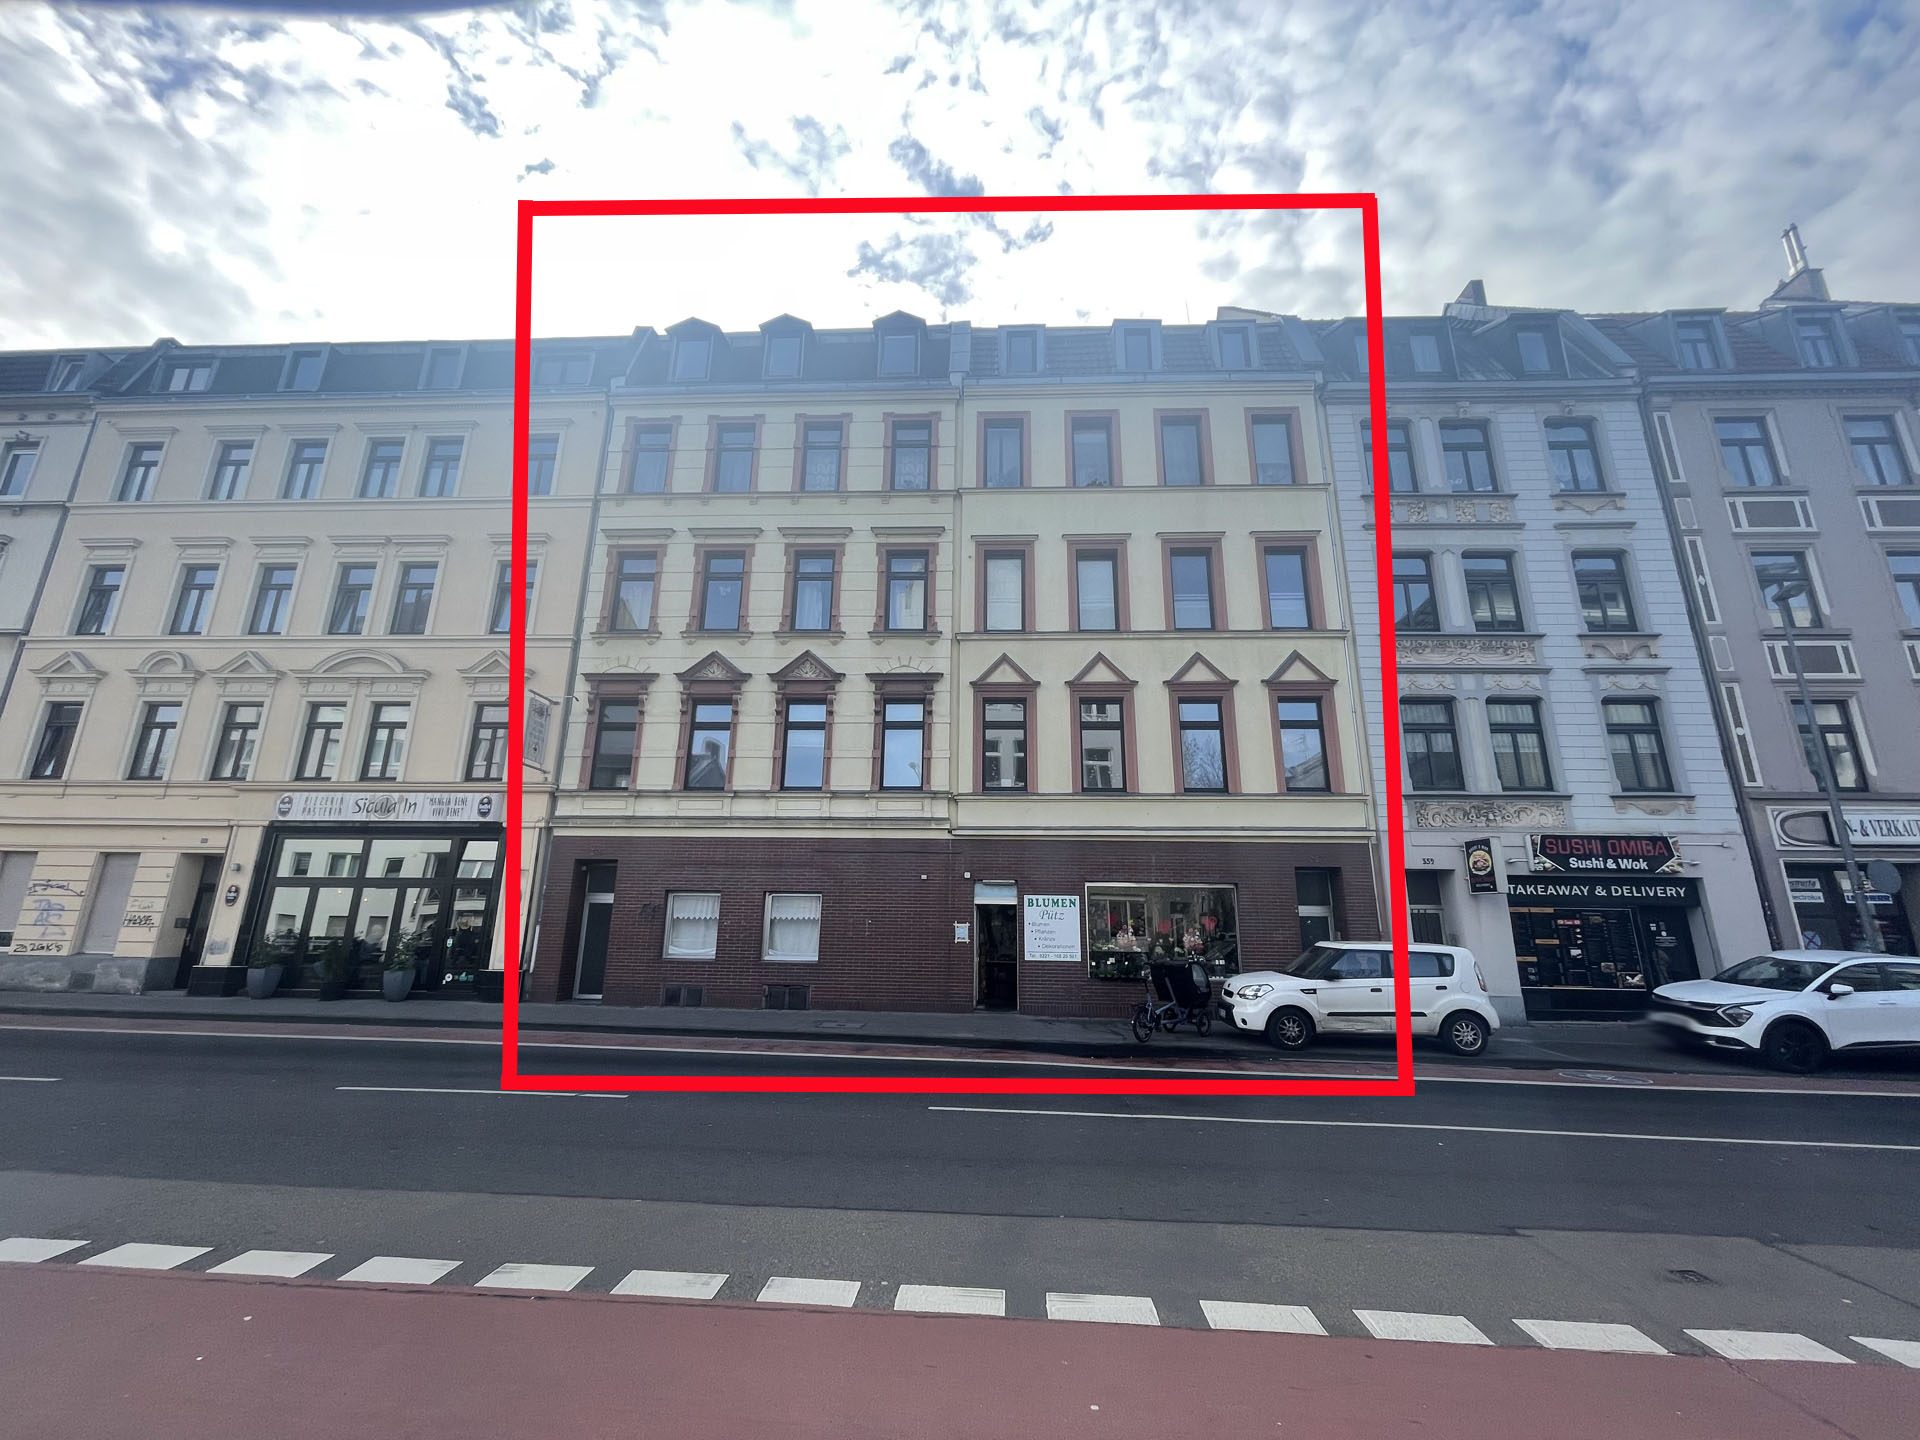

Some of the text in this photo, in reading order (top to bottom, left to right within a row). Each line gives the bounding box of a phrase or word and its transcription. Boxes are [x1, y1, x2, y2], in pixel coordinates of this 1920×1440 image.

[352, 797, 417, 814] Sicula In
[1859, 820, 1870, 837] &
[1545, 838, 1668, 857] SUSHI OMIBA
[1569, 857, 1648, 871] Sushi & Wok
[1508, 884, 1686, 898] TAKEAWAY & DELIVERY
[1027, 898, 1076, 907] BLUMEN
[1039, 910, 1064, 920] Pütz
